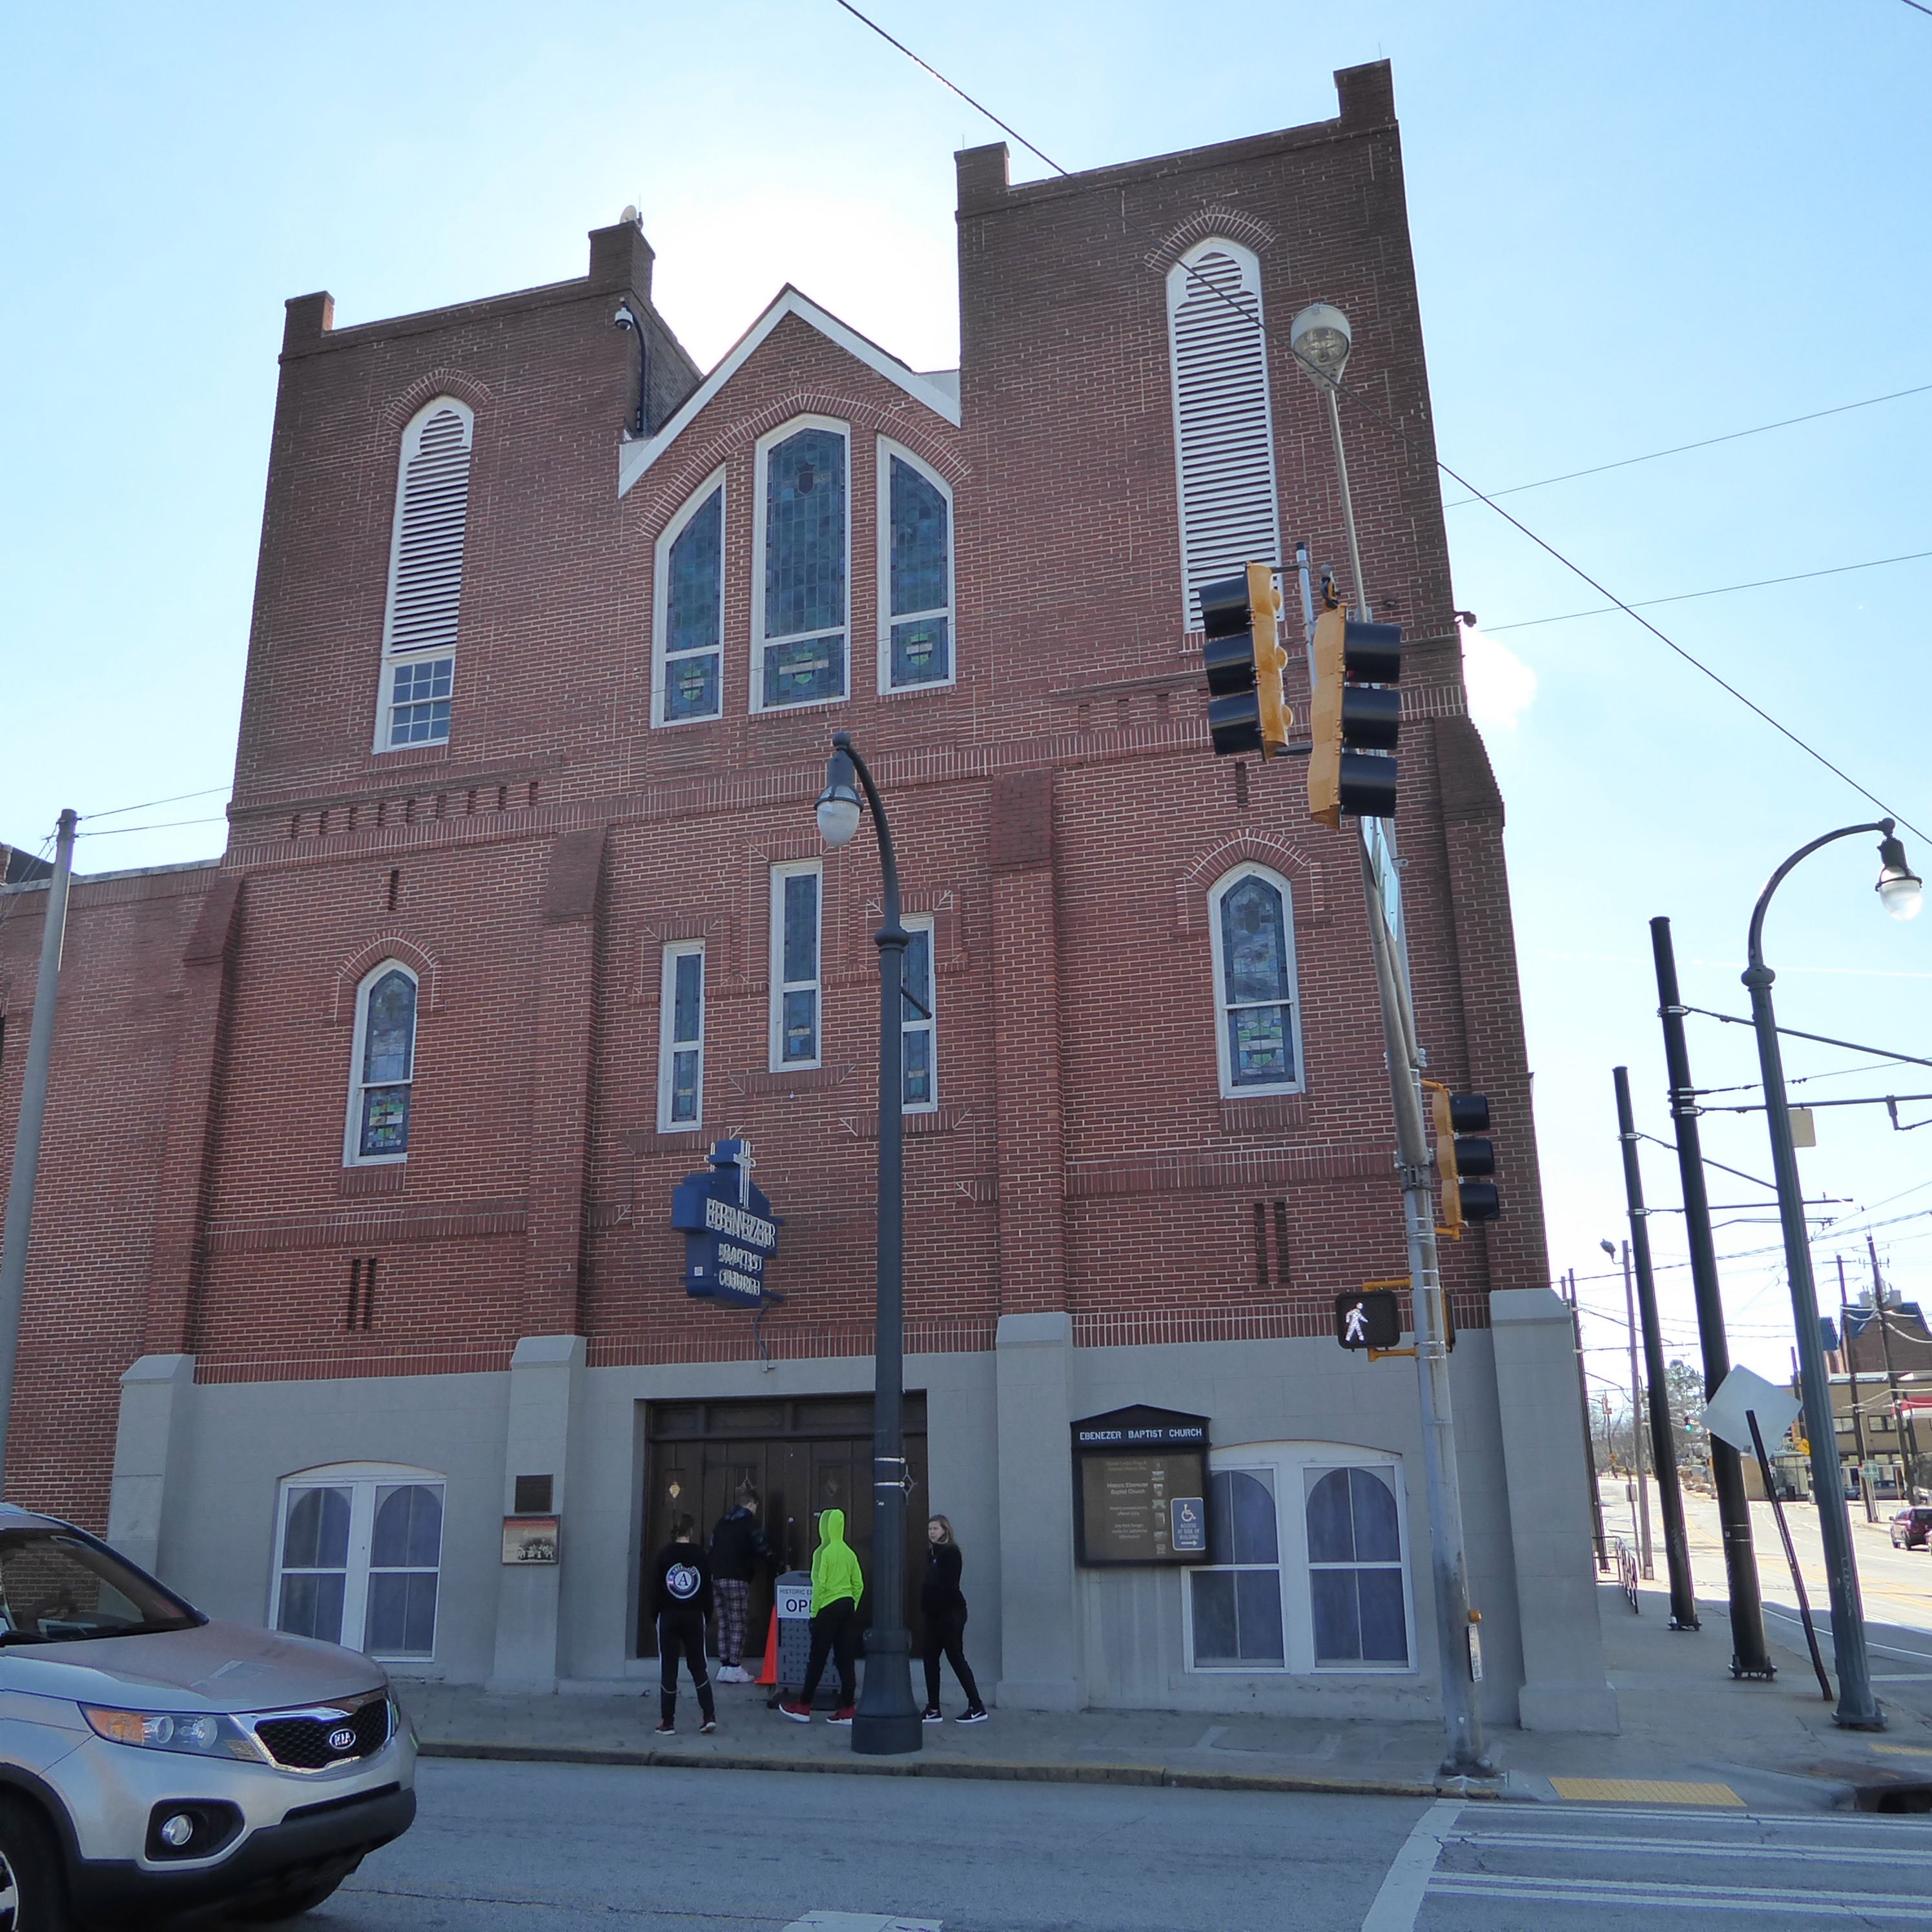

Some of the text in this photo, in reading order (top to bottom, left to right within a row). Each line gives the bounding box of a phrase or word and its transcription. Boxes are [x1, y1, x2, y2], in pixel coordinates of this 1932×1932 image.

[706, 1197, 775, 1248] EBENEZER
[718, 1243, 763, 1272] BAPTIST
[719, 1269, 760, 1296] CHURCH
[1079, 1428, 1202, 1441] EBENEZER BAPTIST CHURCH
[677, 1572, 688, 1586] A
[334, 1732, 351, 1746] KIA
